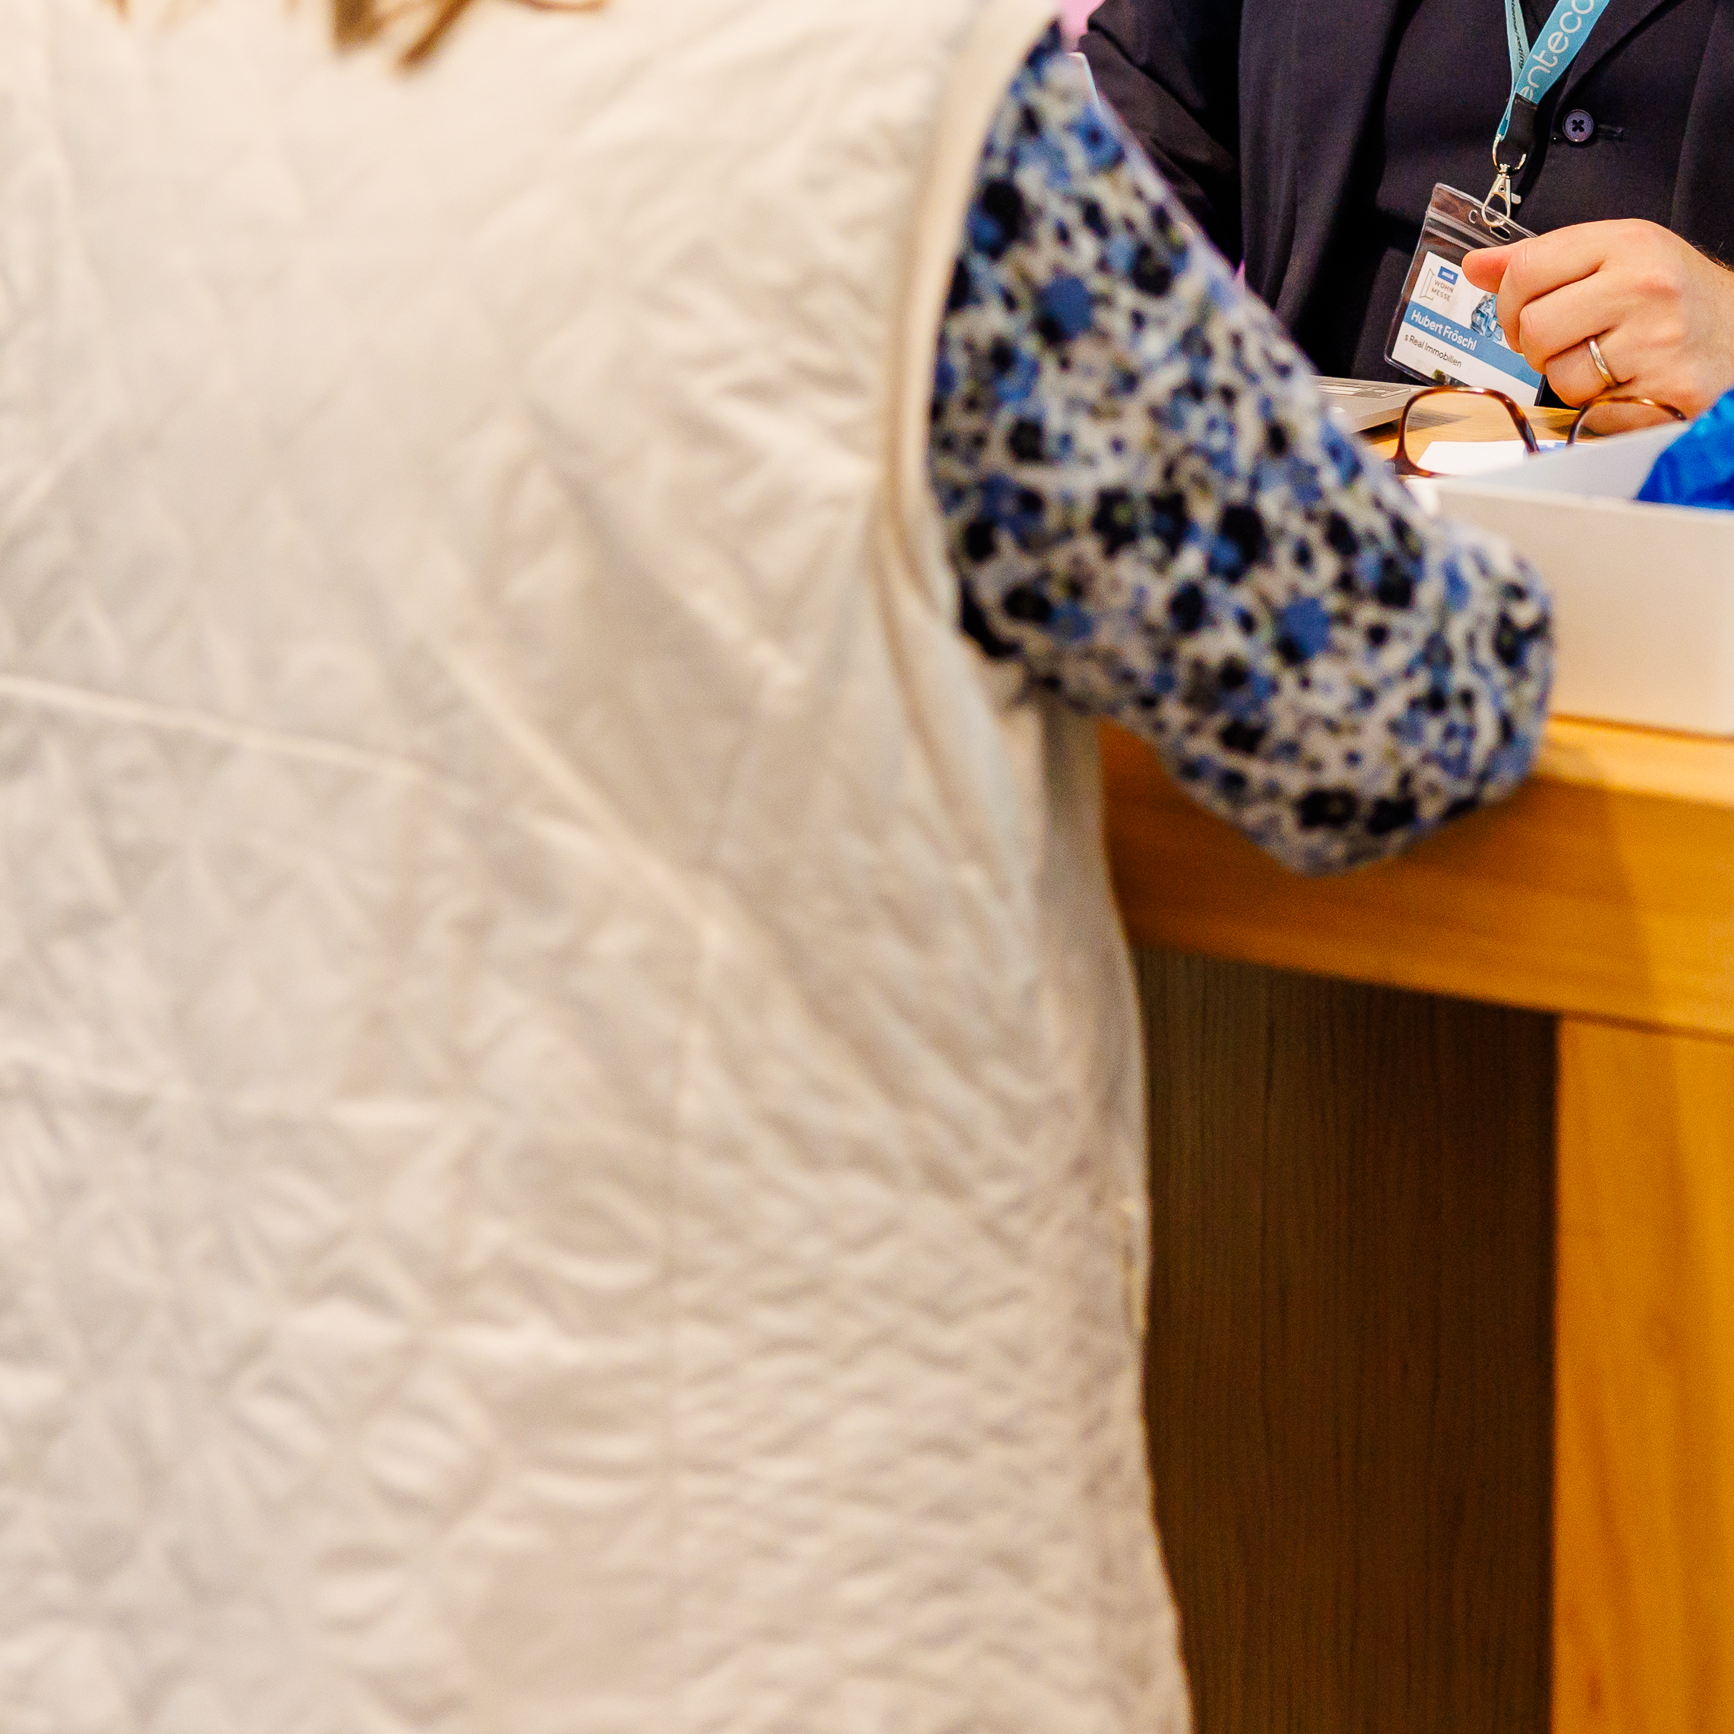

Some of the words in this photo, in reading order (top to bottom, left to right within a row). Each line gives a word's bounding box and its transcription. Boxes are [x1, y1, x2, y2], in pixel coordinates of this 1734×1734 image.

[1431, 287, 1451, 302] MESSE
[1434, 278, 1455, 293] WOHN
[1411, 309, 1443, 334] Hubert
[1444, 325, 1478, 351] Fröschl
[1409, 335, 1424, 349] Real
[1424, 343, 1462, 368] Immobilien
